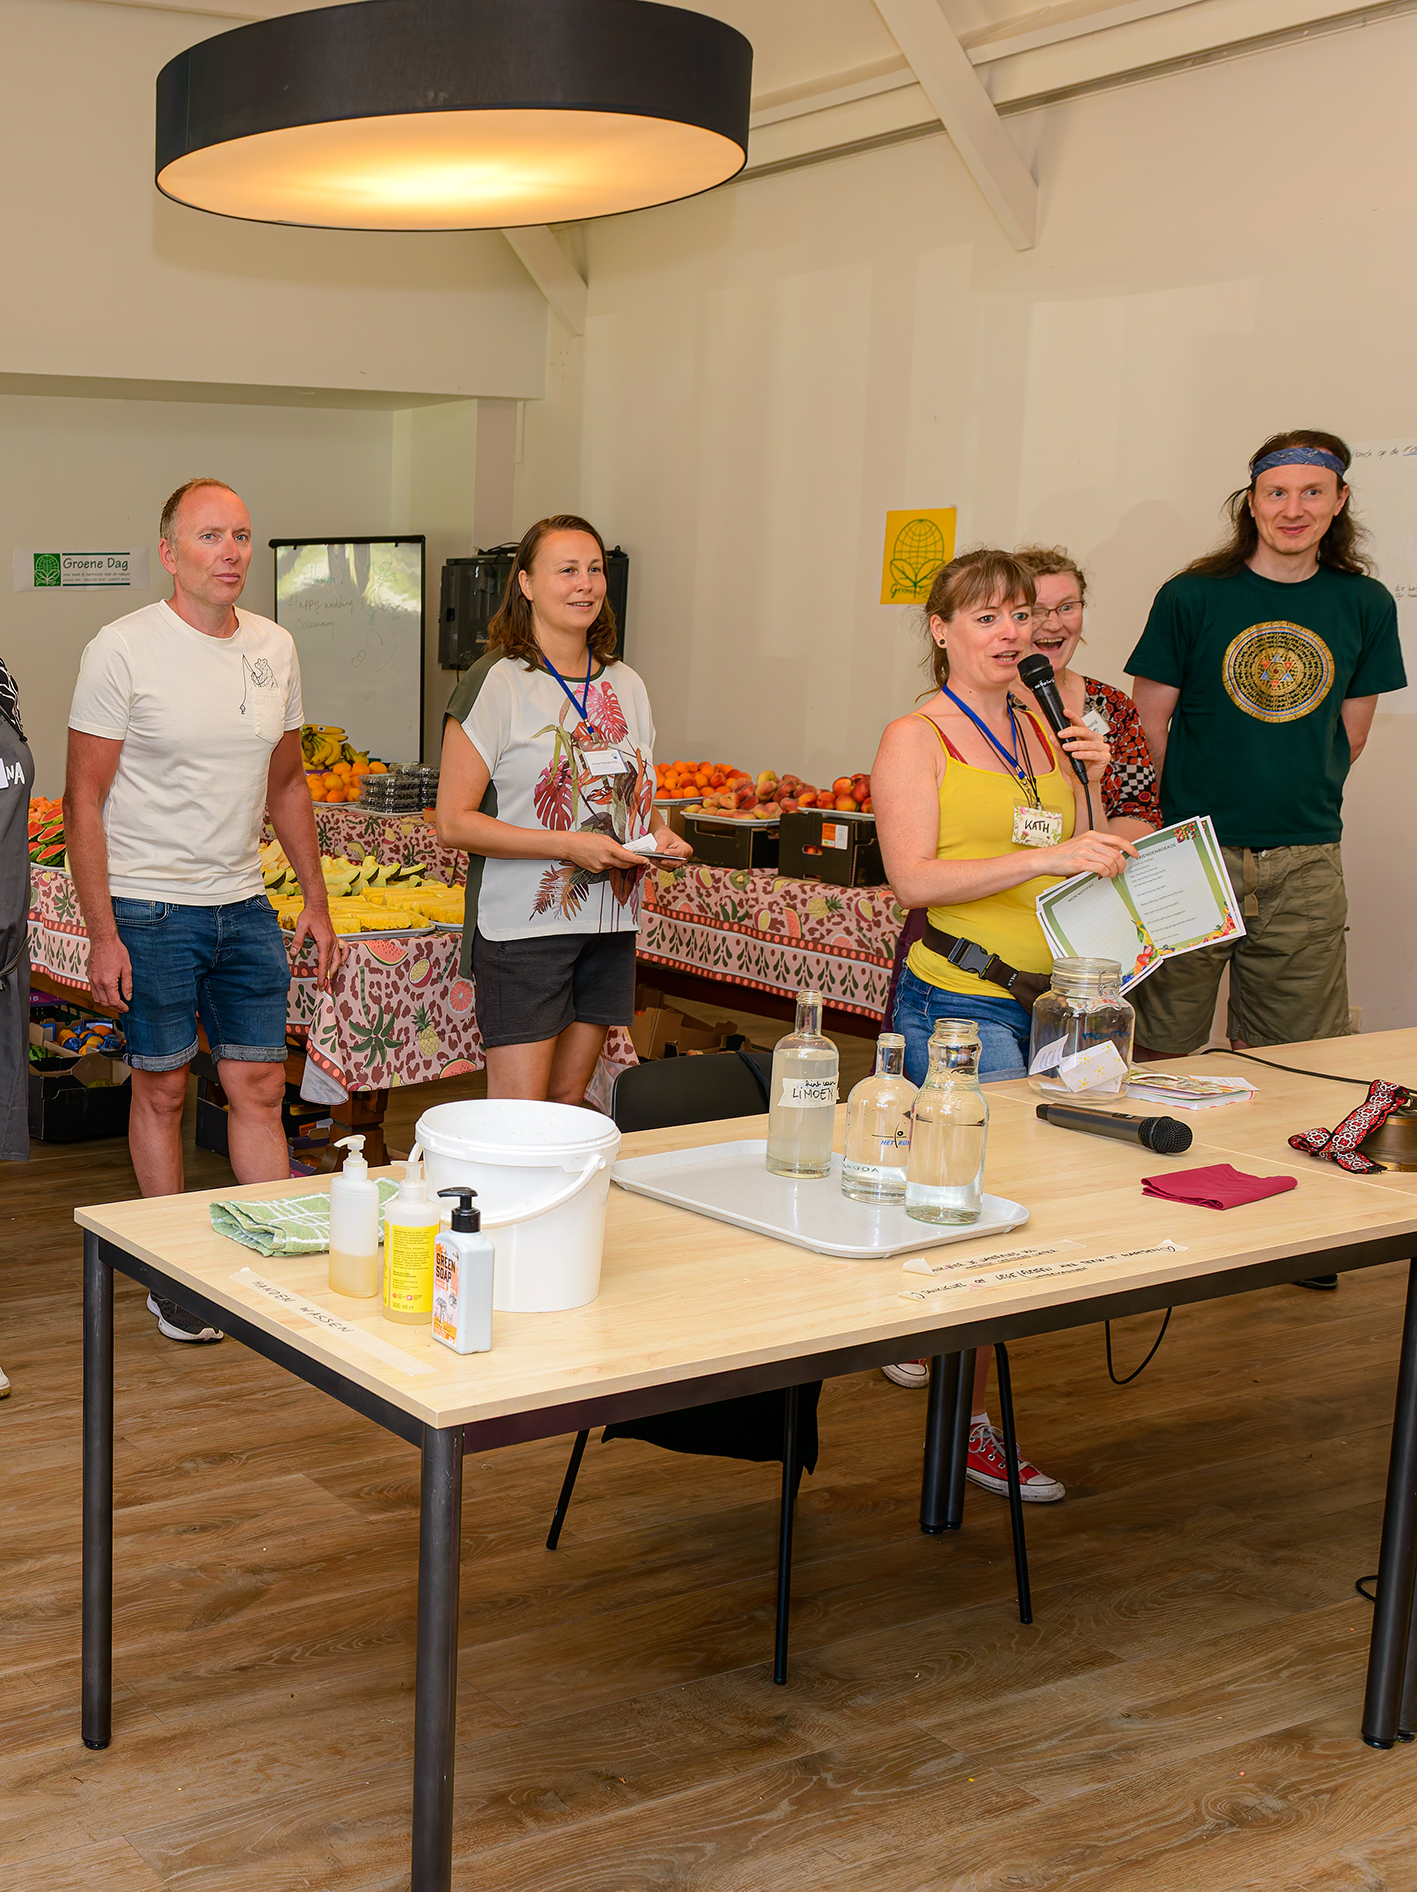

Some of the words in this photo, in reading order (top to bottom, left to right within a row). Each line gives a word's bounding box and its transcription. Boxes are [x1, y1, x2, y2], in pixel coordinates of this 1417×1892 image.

[62, 557, 104, 569] Groene
[107, 557, 129, 571] Dag
[284, 594, 321, 615] Happy
[1024, 819, 1050, 834] KATH
[436, 1252, 456, 1273] GREEN
[435, 1265, 452, 1283] SOAP
[251, 1280, 296, 1303] HANDEN
[299, 1306, 354, 1333] WASSEN
[392, 1301, 401, 1309] 300
[401, 1302, 408, 1310] ml
